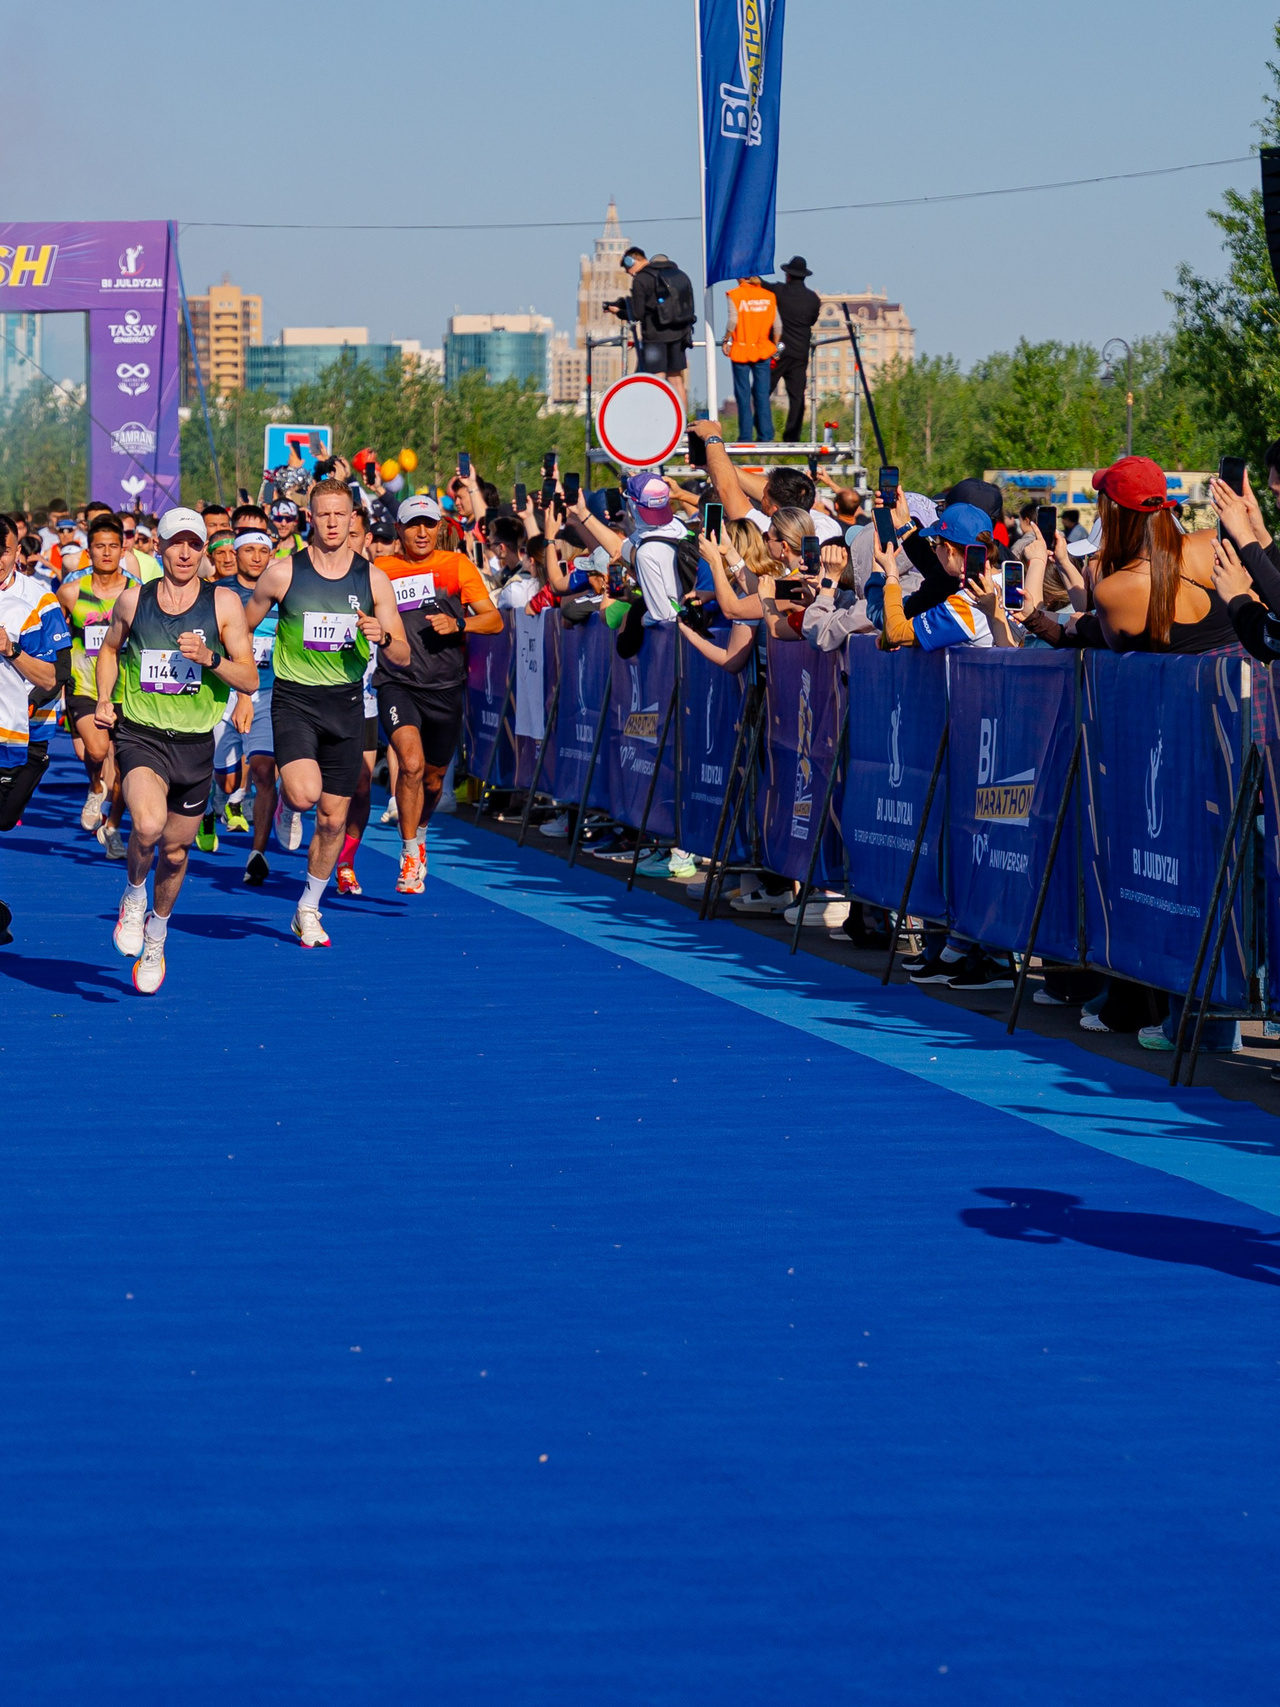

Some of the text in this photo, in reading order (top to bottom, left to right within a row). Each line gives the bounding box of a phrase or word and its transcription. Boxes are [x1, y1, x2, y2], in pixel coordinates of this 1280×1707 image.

[101, 278, 163, 288] BI JULDYZAI
[108, 324, 158, 337] TASSAY
[113, 336, 152, 344] ENERGY
[422, 585, 430, 595] A
[313, 626, 352, 639] 1117 A
[149, 665, 196, 680] 1144 A
[977, 718, 998, 785] BI
[975, 787, 1034, 816] MARATHON
[884, 799, 913, 826] JULDYZAI
[1132, 847, 1179, 886] BI JULDYZAI
